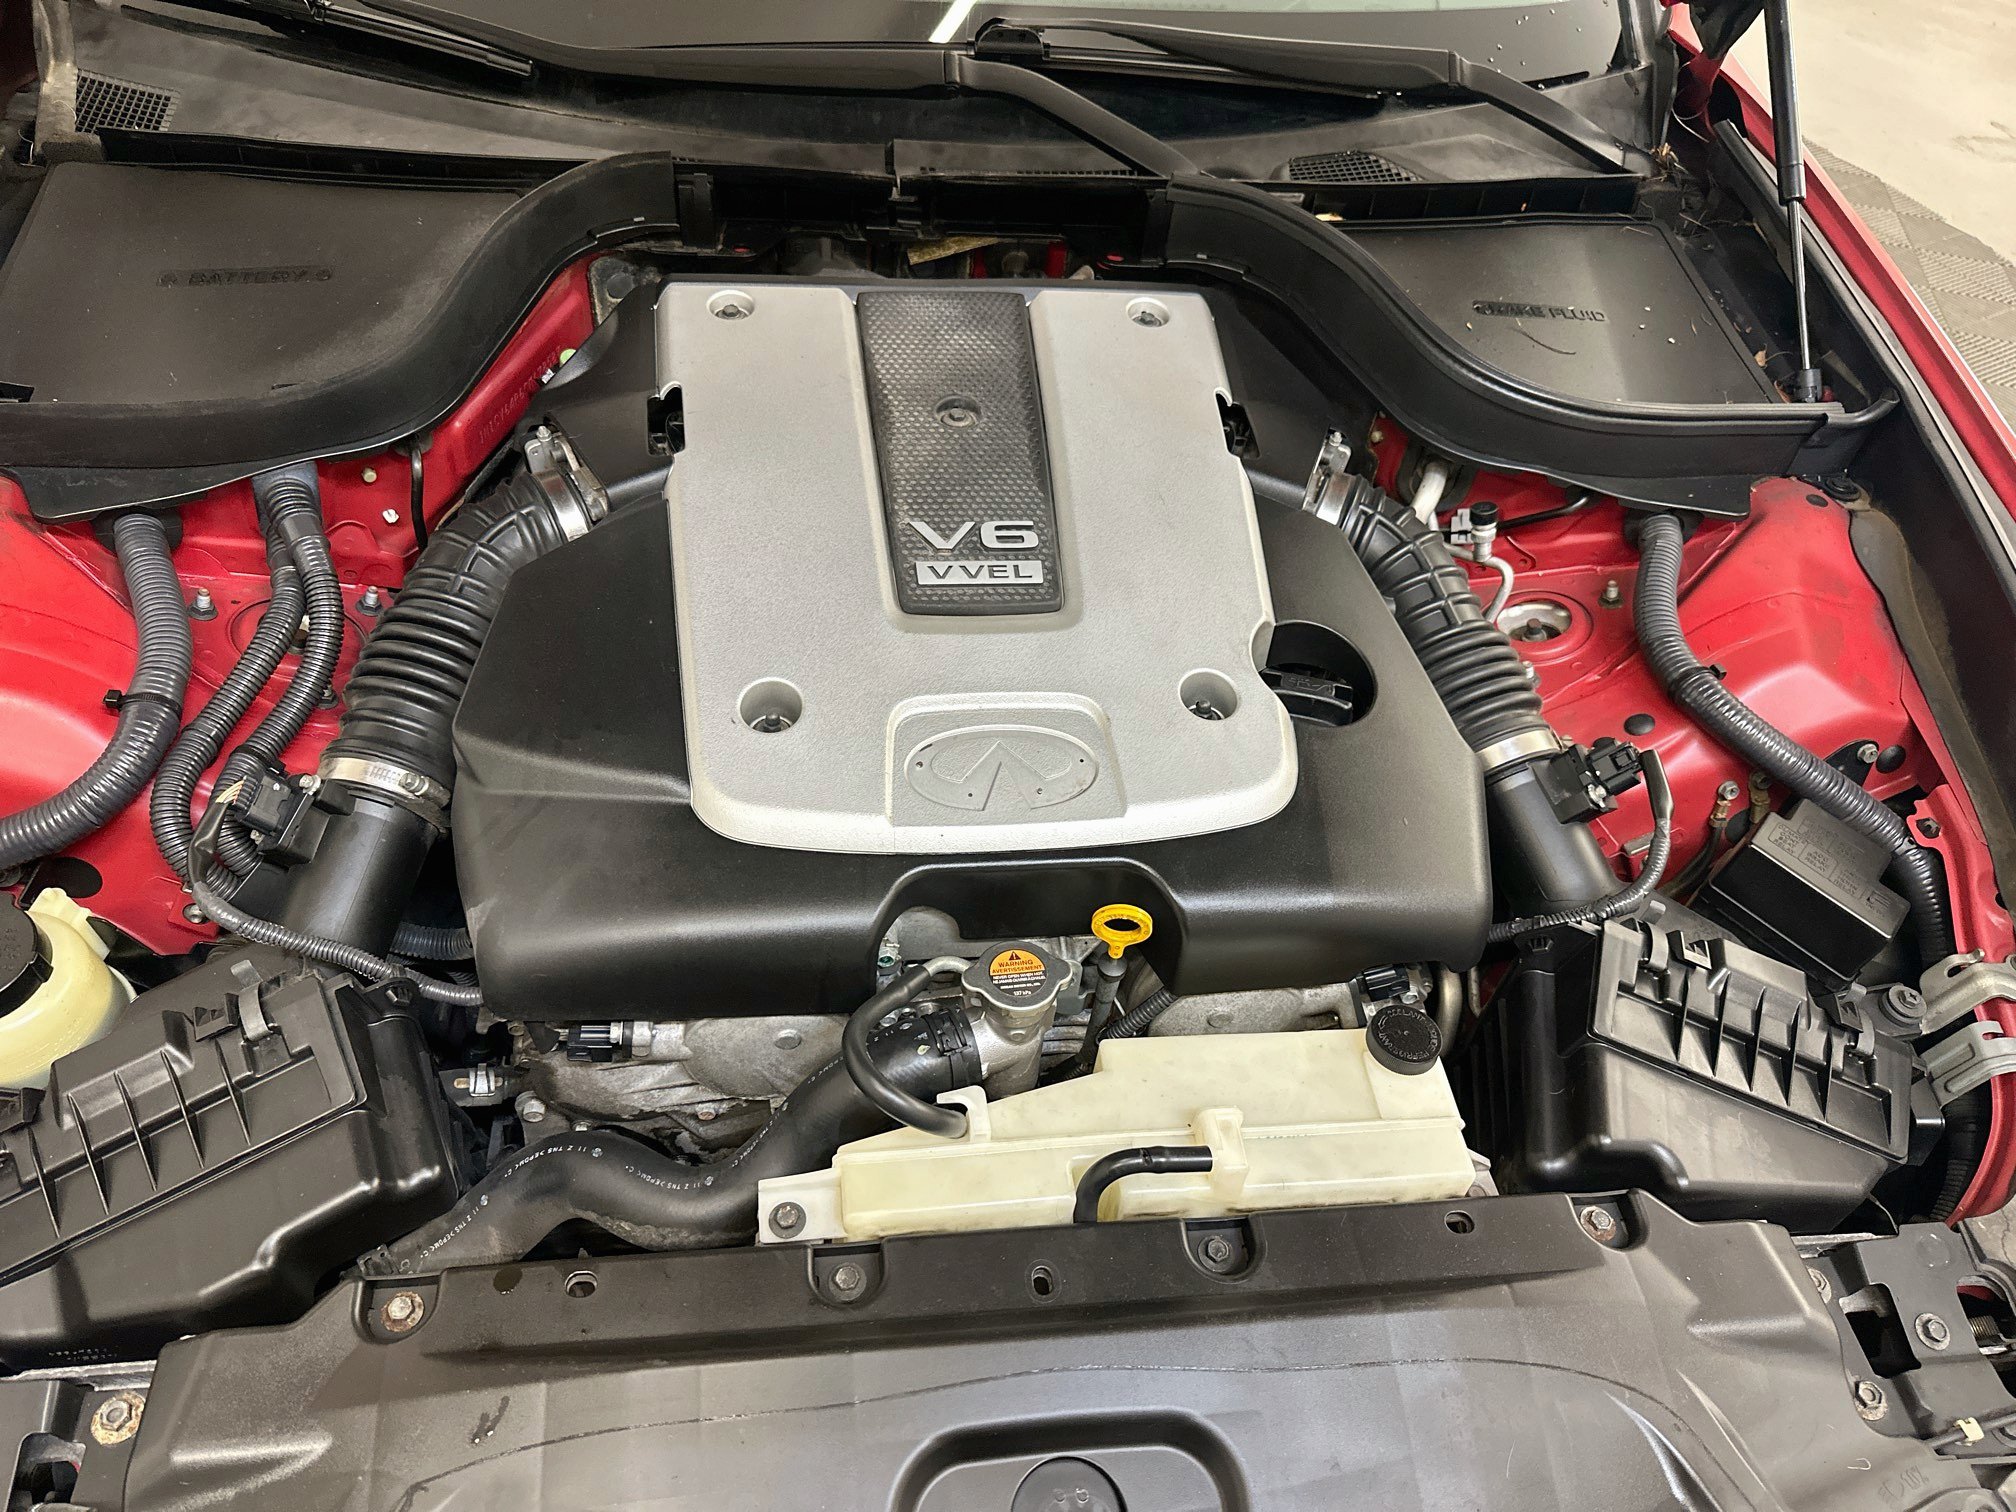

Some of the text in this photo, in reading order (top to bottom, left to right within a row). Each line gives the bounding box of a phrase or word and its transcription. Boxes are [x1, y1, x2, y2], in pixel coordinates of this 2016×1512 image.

[188, 268, 308, 286] BATTERY
[1548, 307, 1606, 322] FLUID
[908, 521, 1039, 549] V6
[927, 565, 1033, 579] VVEL
[992, 965, 1042, 973] AVERTISSEMENT
[998, 959, 1033, 967] WARNING
